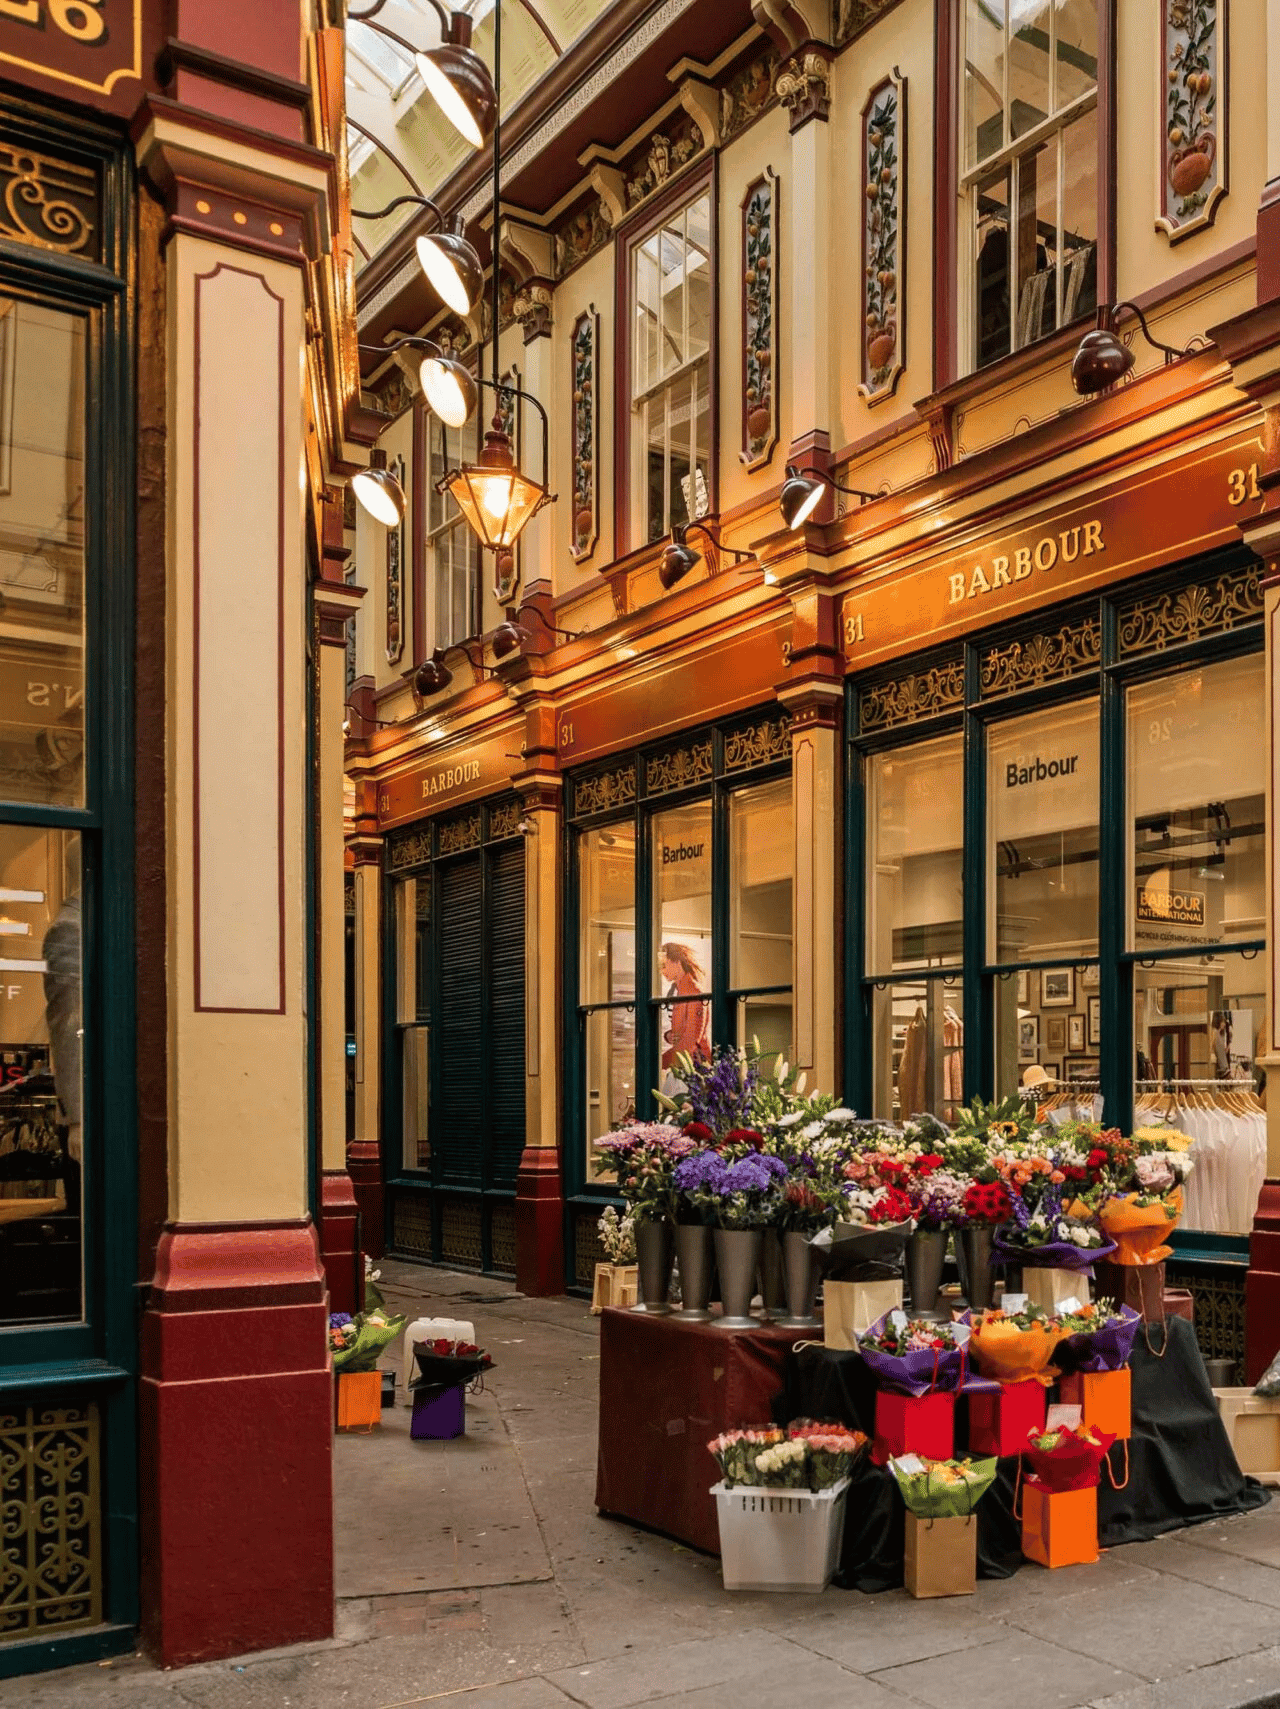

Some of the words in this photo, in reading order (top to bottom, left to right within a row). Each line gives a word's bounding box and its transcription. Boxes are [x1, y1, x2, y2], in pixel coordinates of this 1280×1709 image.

[1228, 463, 1260, 505] 31
[948, 519, 1105, 605] BARBOUR
[844, 612, 865, 645] 31
[561, 723, 574, 746] 31
[421, 760, 481, 799] BARBOUR
[1006, 754, 1079, 789] Barbour
[381, 795, 390, 813] 31
[662, 843, 705, 865] Barbour
[1138, 907, 1203, 922] INTERNATIONAL
[1140, 891, 1200, 911] BARBOUR
